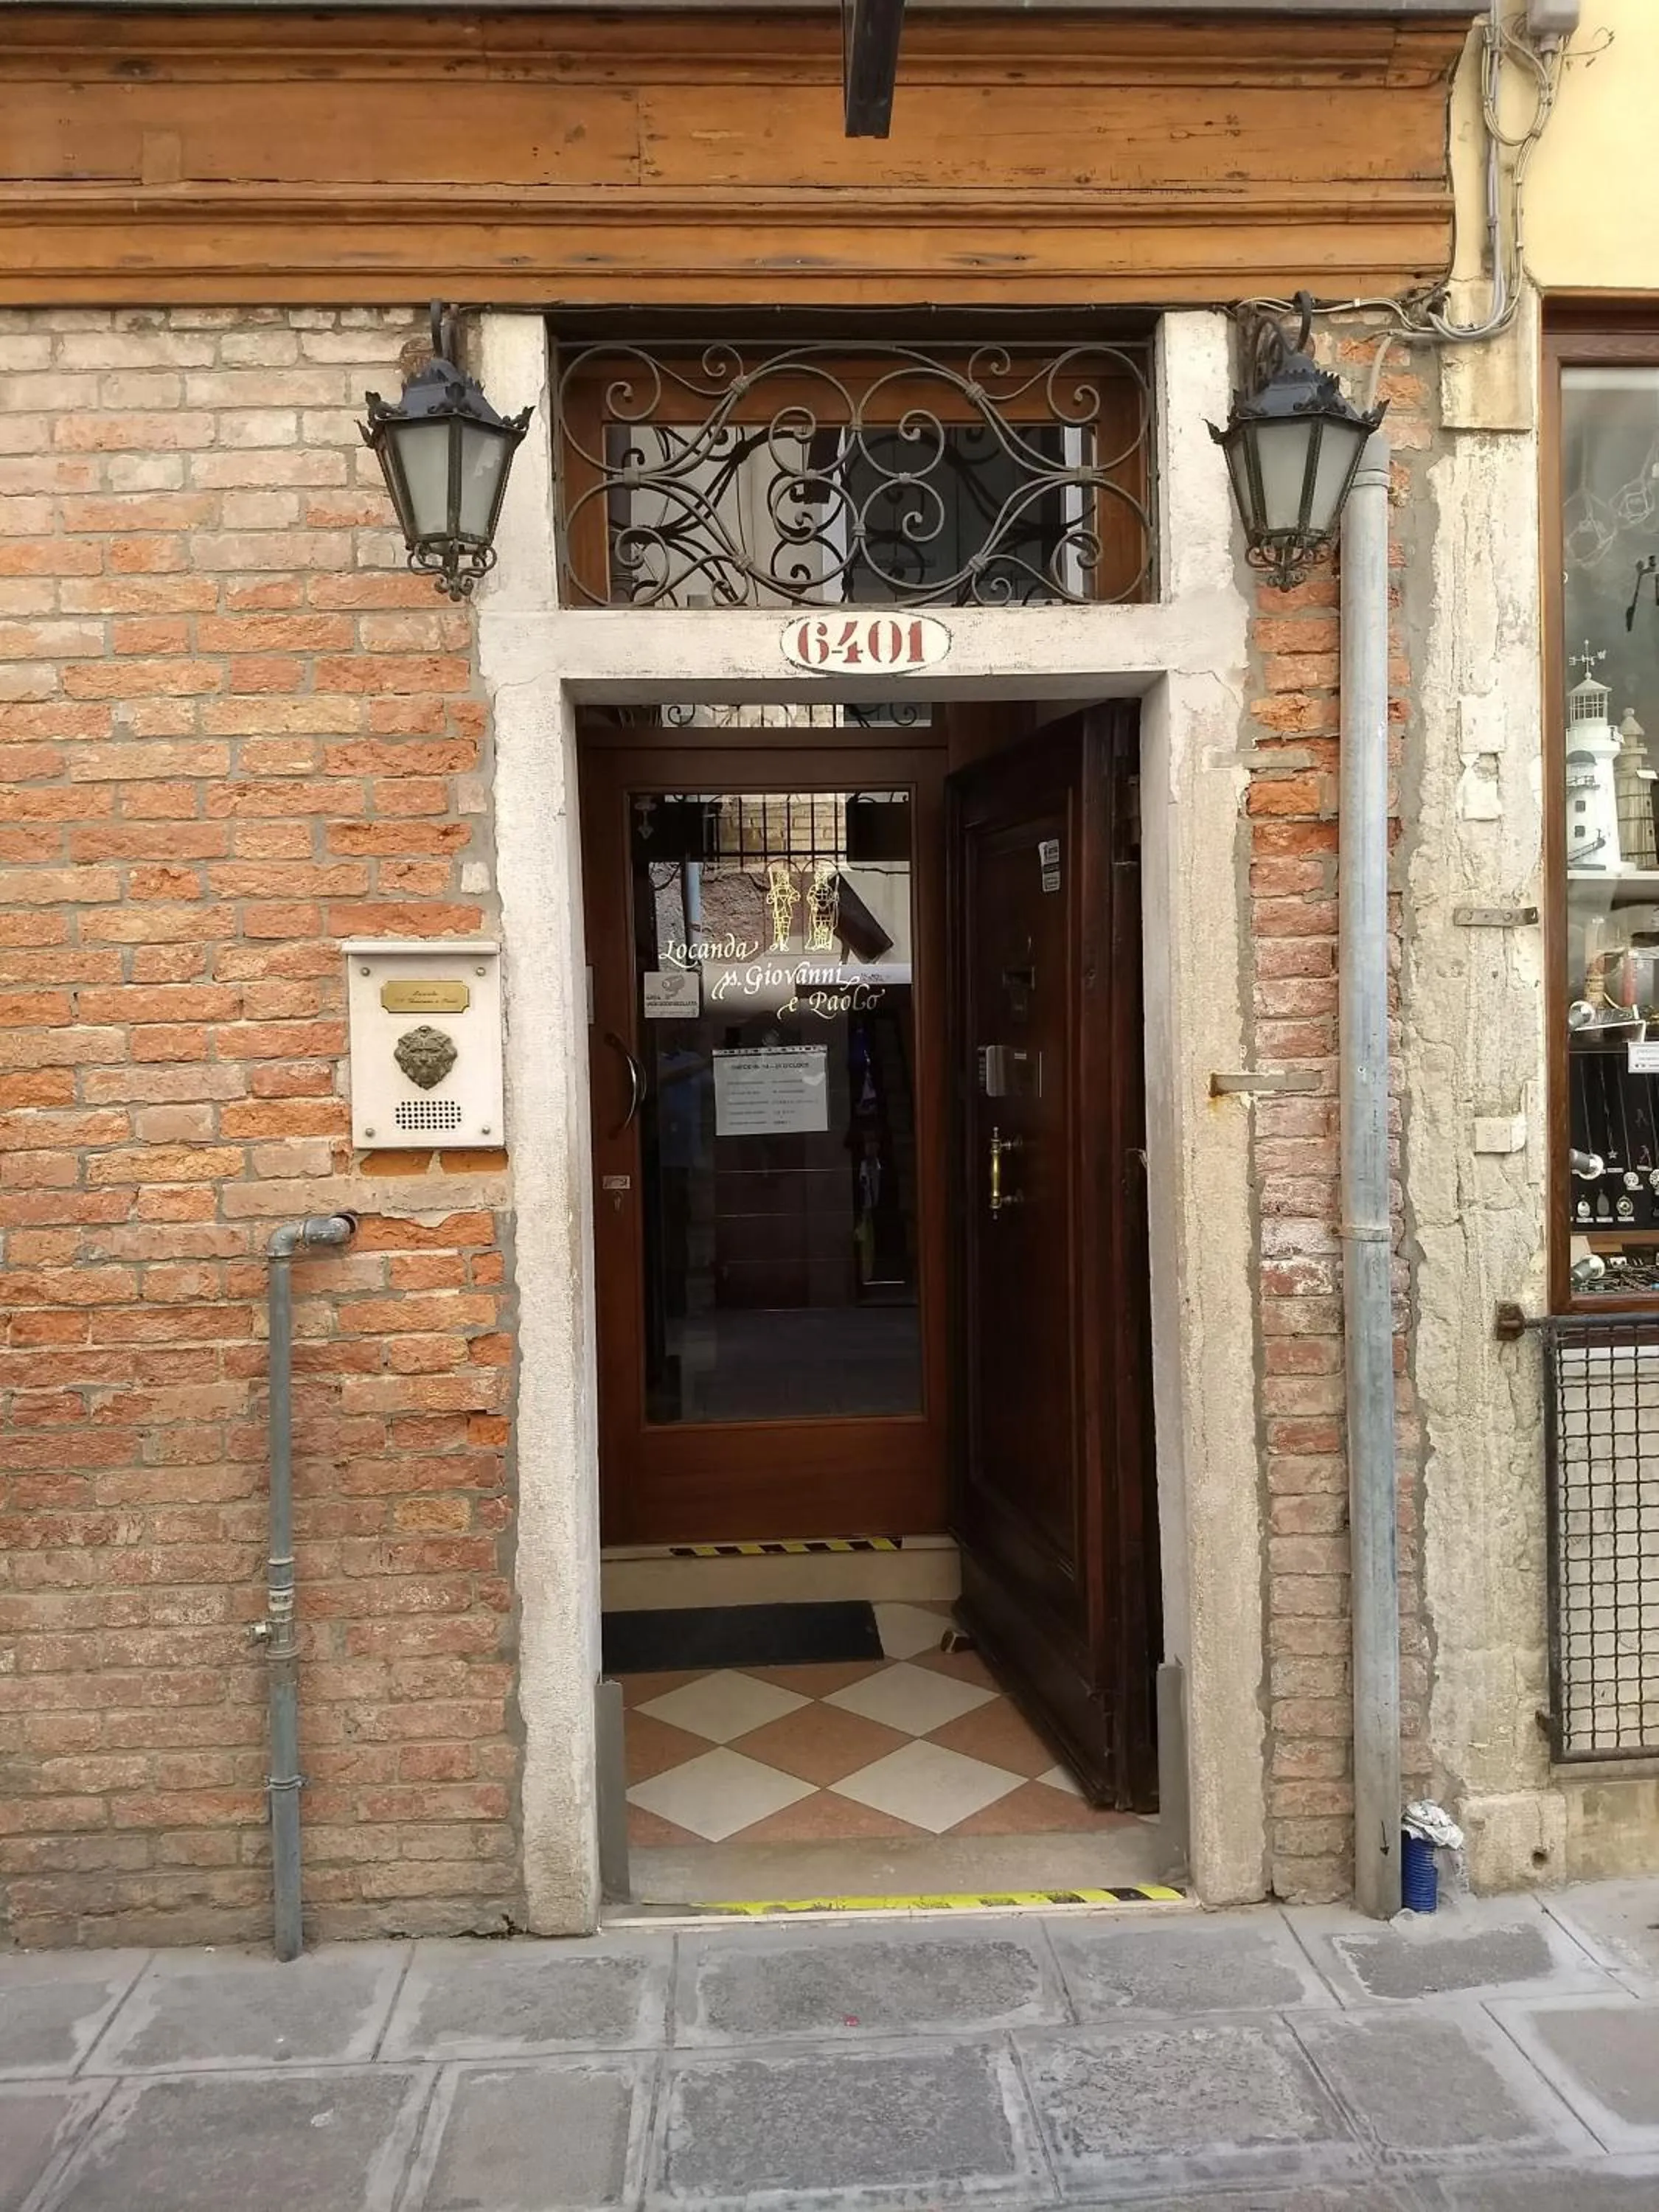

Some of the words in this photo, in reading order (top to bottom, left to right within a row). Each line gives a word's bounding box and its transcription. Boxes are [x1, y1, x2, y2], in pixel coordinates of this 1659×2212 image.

[797, 619, 925, 664] 6401
[658, 932, 759, 969] Locanda
[743, 961, 860, 995] Giovanni
[776, 996, 799, 1020] e
